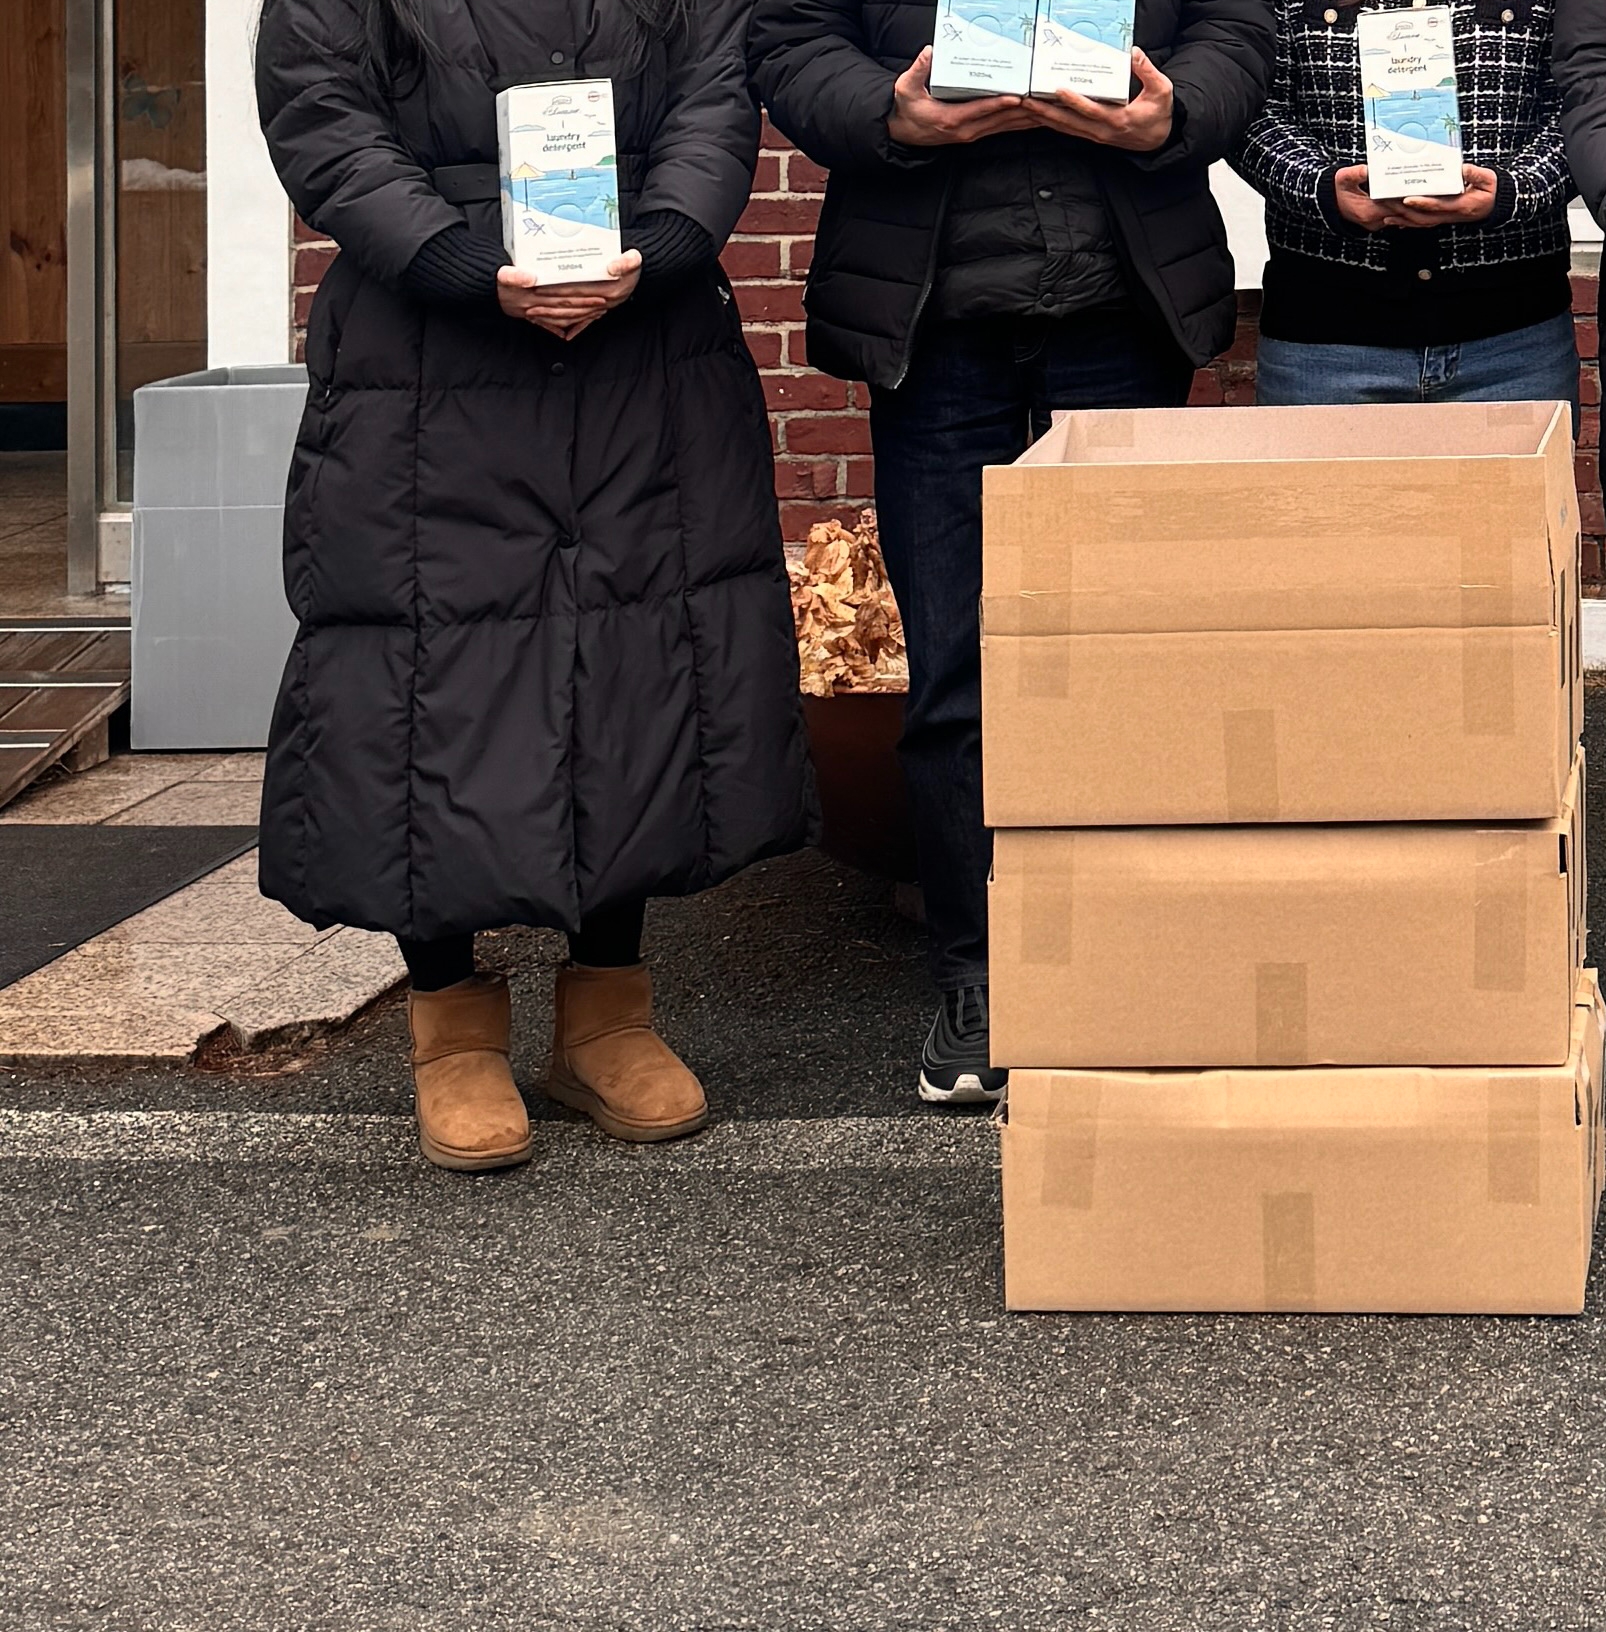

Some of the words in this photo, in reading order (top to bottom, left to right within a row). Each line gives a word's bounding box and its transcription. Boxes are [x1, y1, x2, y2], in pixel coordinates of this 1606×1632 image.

[1391, 56, 1422, 66] laundry
[1387, 64, 1427, 74] detergent
[546, 133, 581, 143] laundry
[542, 142, 587, 153] detergent
